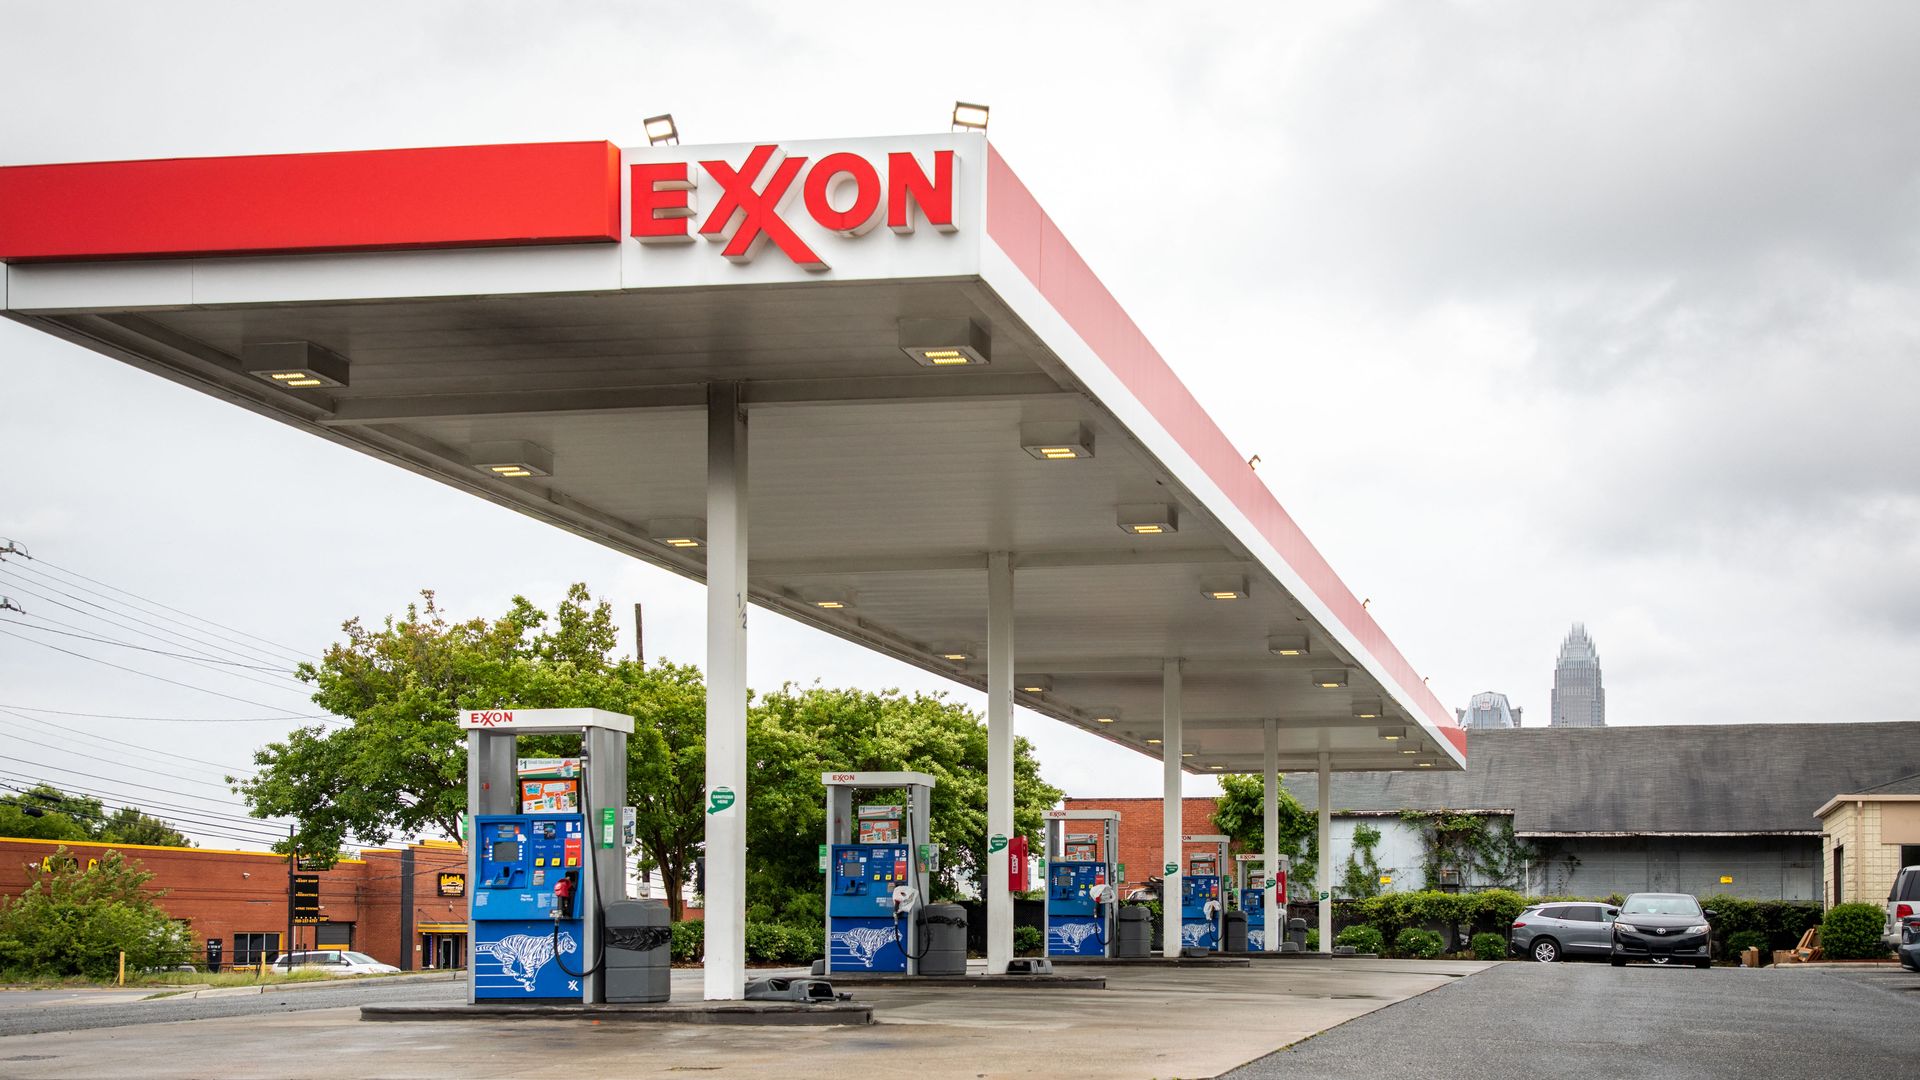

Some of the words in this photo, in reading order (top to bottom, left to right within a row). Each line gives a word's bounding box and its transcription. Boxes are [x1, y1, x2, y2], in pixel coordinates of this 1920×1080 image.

[630, 144, 960, 269] EXXON
[471, 711, 513, 727] EXXON
[832, 774, 855, 783] EXXON
[575, 821, 581, 832] 1
[901, 849, 907, 857] 3
